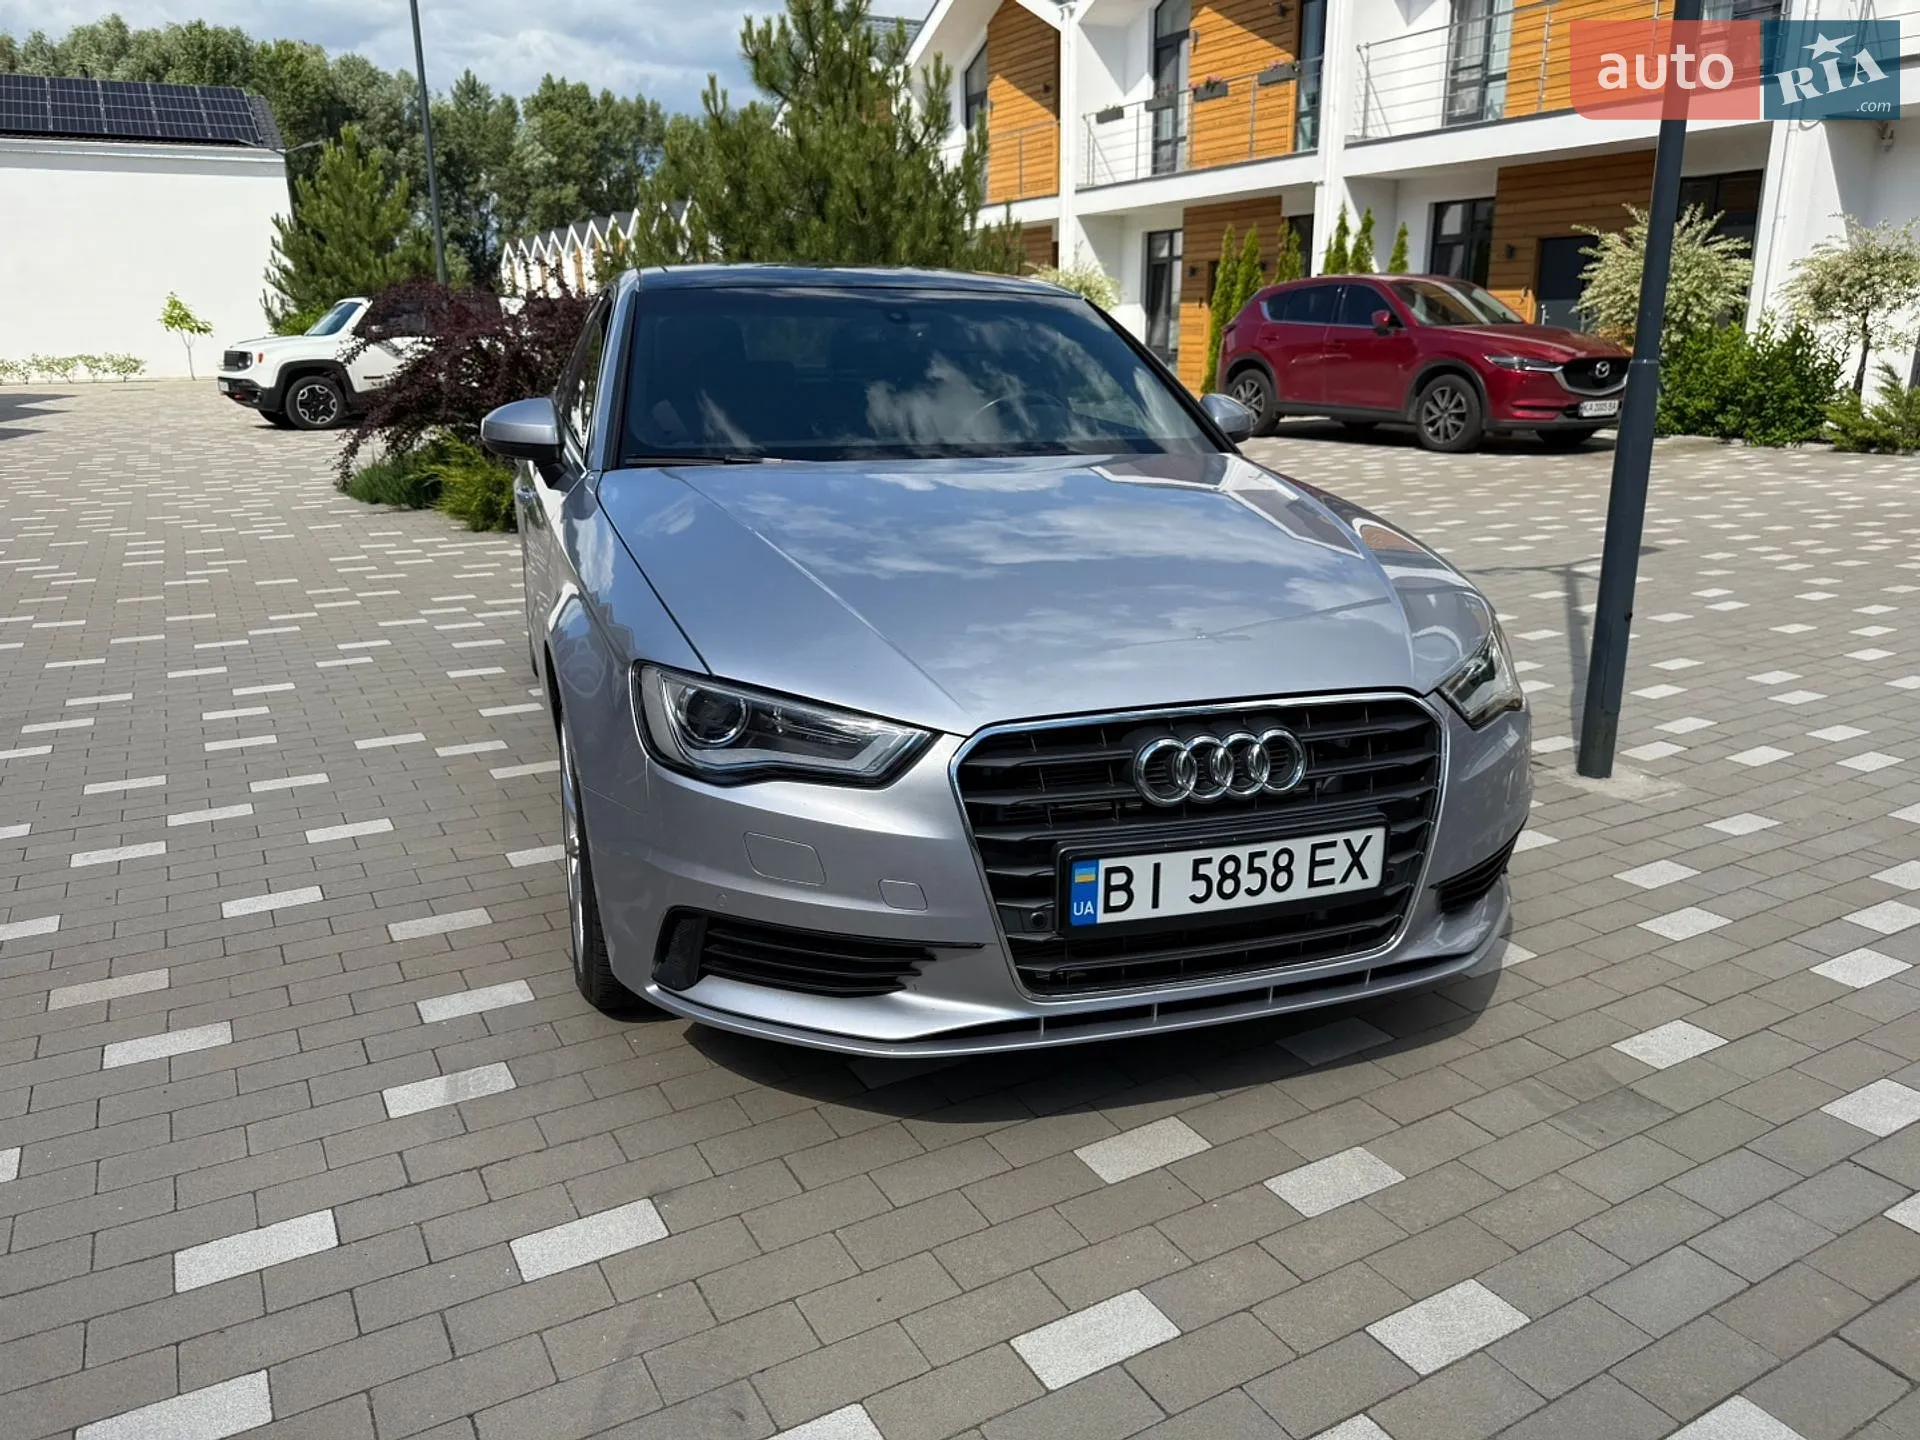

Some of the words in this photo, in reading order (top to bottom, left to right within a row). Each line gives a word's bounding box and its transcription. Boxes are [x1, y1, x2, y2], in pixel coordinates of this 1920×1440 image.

[1103, 862, 1160, 914] BI
[1189, 847, 1294, 904] 5858
[1307, 835, 1373, 889] EX
[1073, 900, 1095, 916] UA
